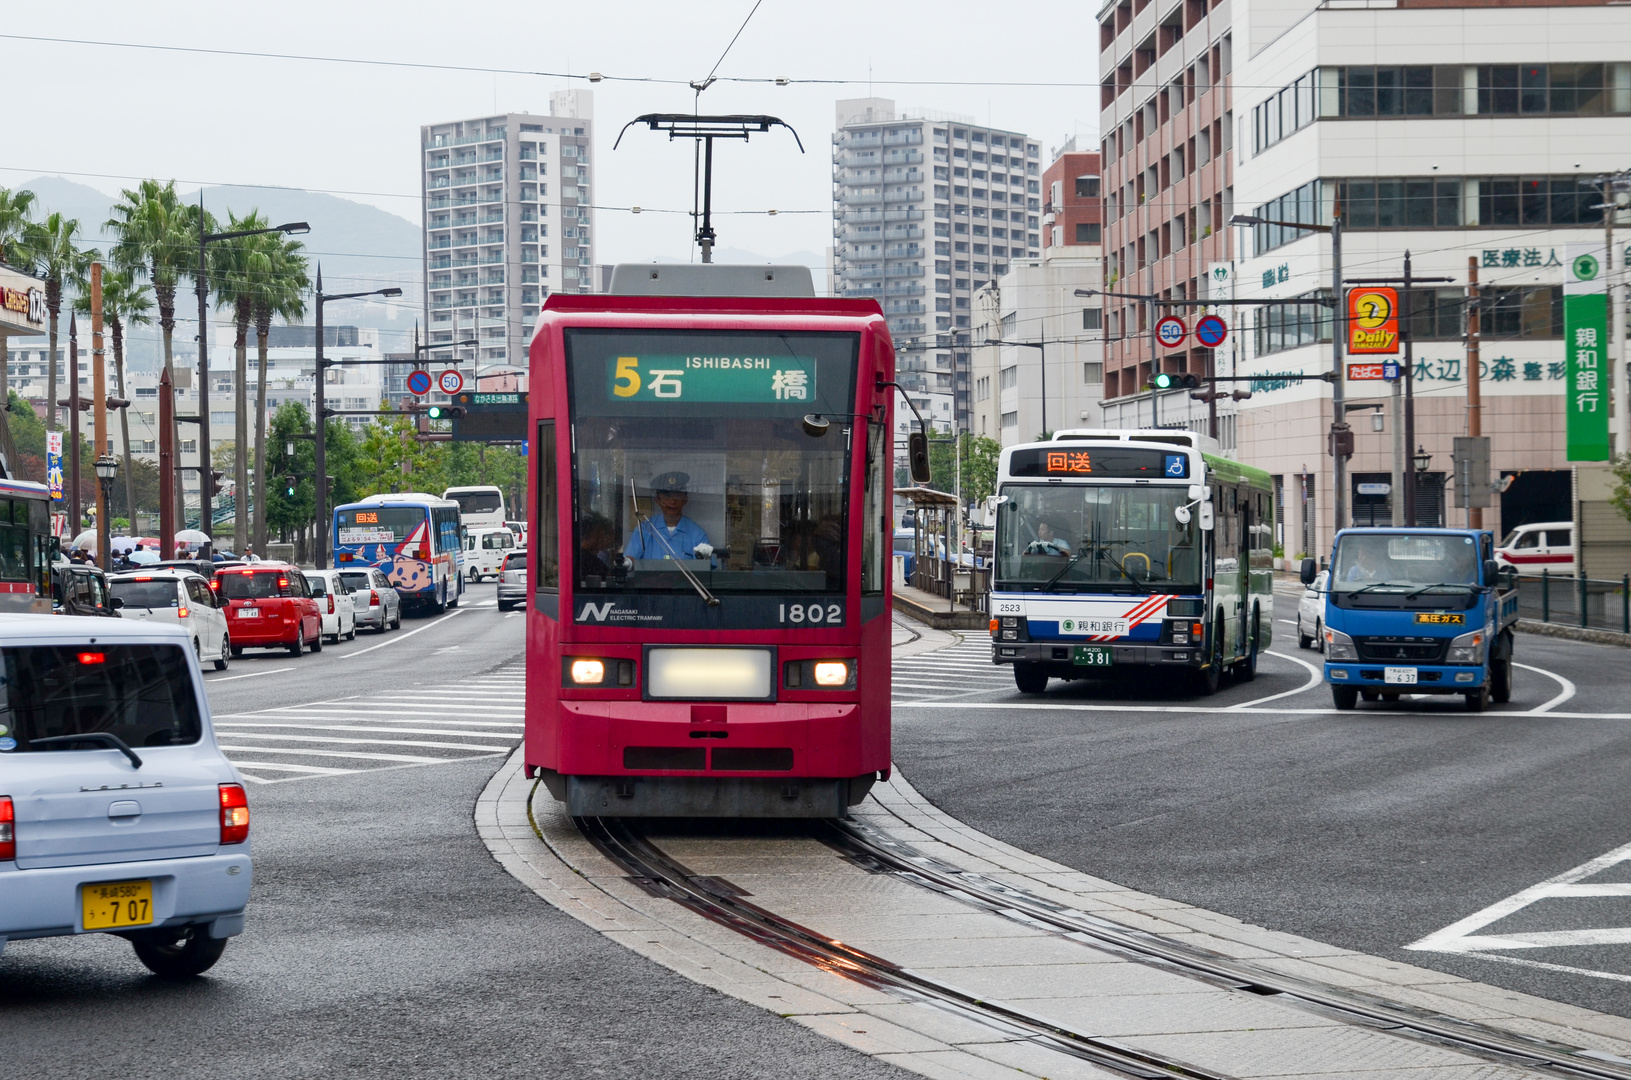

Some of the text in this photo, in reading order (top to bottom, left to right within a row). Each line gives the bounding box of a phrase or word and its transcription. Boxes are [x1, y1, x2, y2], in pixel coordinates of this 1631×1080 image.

[1482, 248, 1563, 268] 医療法人
[1162, 325, 1180, 339] 50
[1353, 330, 1397, 348] Daily
[686, 357, 770, 369] ISHIBASHI
[1575, 327, 1599, 412] 親和銀行
[613, 357, 641, 397] 5
[1351, 366, 1397, 378] たばこ 酒
[444, 377, 458, 388] 50
[1047, 452, 1091, 472] 回送
[356, 512, 378, 524] 回送
[779, 603, 841, 623] 1802
[1000, 604, 1020, 612] 2523
[1419, 614, 1461, 623] 高圧ガス
[1078, 621, 1125, 632] 親和銀行
[100, 886, 137, 899] 長崎580
